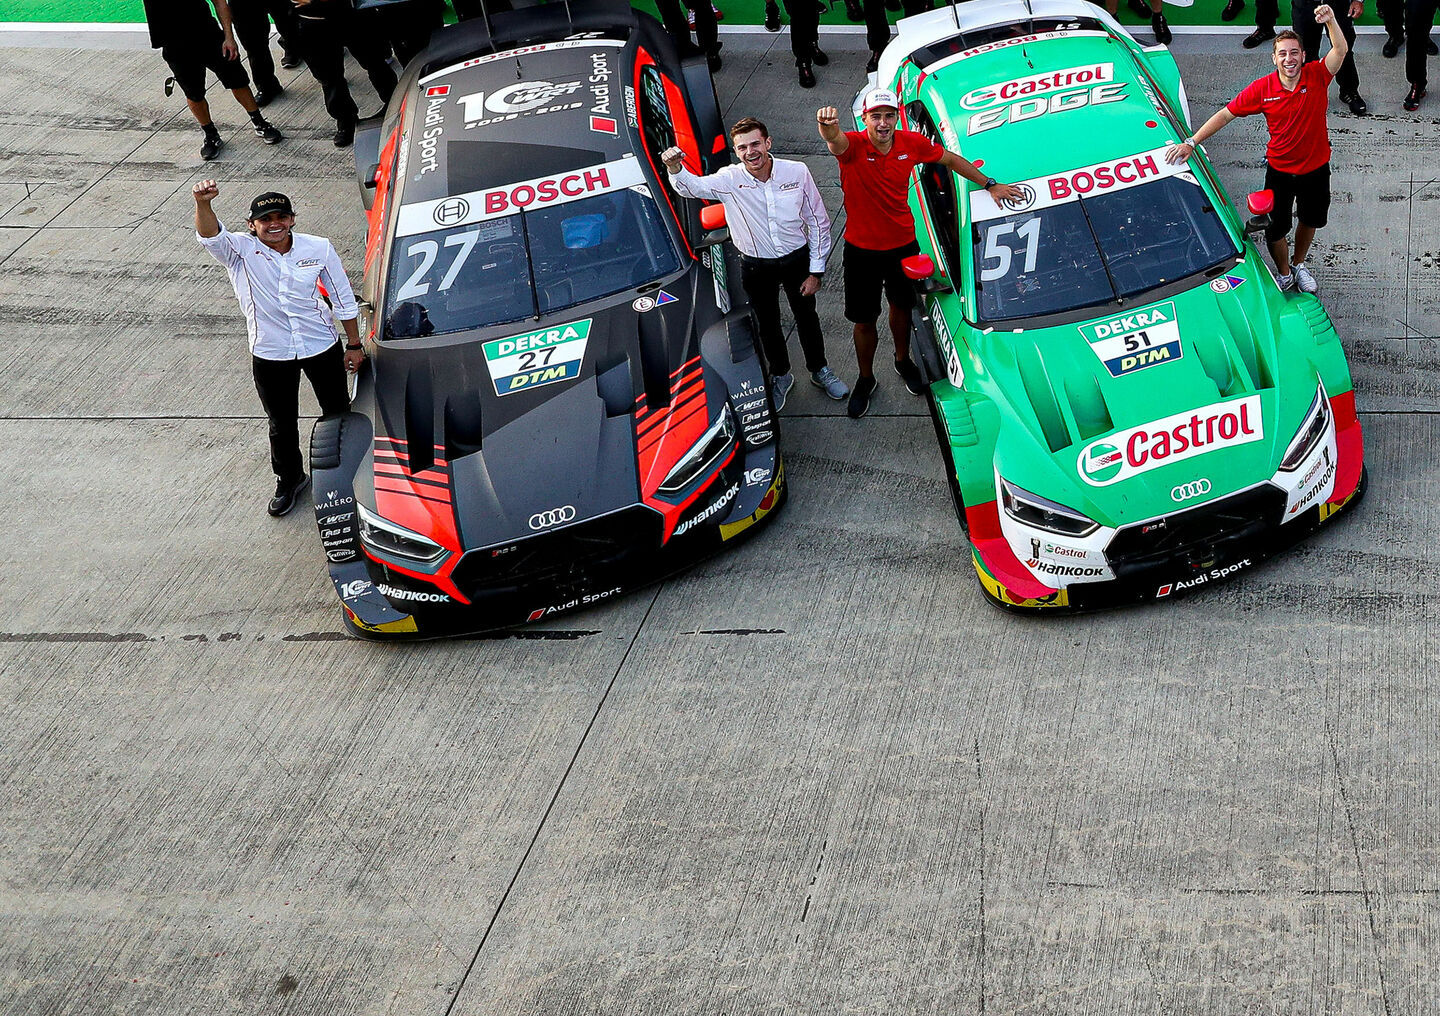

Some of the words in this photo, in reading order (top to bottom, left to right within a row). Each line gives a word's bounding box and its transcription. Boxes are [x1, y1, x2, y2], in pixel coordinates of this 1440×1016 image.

[464, 45, 546, 67] BOSCH
[964, 36, 1038, 57] BOSCH
[588, 52, 613, 83] Sport
[1000, 66, 1106, 99] Castrol
[424, 98, 447, 128] Audi
[590, 84, 611, 114] Audi
[967, 82, 1130, 137] EDGE
[464, 113, 519, 130] 2009
[536, 102, 584, 116] 2019
[418, 127, 444, 175] Sport
[485, 168, 611, 215] BOSCH
[1048, 156, 1160, 201] BOSCH
[980, 218, 1042, 282] 51
[396, 230, 481, 302] 27
[1094, 309, 1168, 339] DEKRA
[498, 326, 579, 356] DEKRA
[1124, 332, 1152, 352] 51
[518, 346, 557, 372] 27
[1122, 346, 1170, 371] DTM
[510, 365, 566, 389] DTM
[731, 386, 765, 400] WALERO
[743, 398, 766, 410] WRT
[1126, 403, 1255, 468] Castrol
[1304, 458, 1322, 484] Castrol
[314, 496, 353, 511] WALERO
[326, 512, 355, 524] WRT
[1054, 546, 1087, 559] Castrol
[1175, 573, 1209, 592] Audi
[1212, 558, 1252, 579] Sport
[546, 599, 579, 614] Audi
[582, 587, 622, 604] Sport
